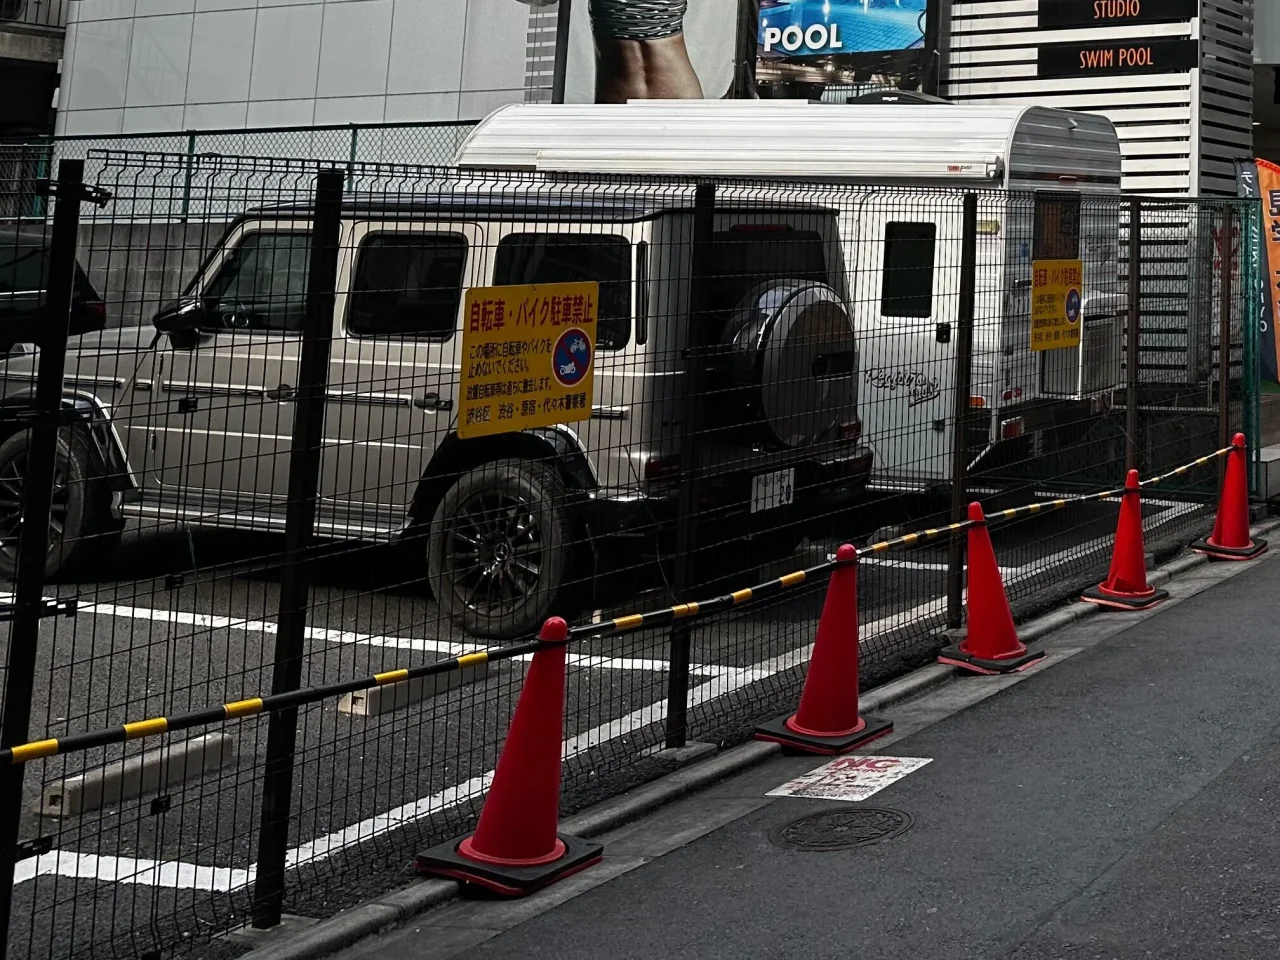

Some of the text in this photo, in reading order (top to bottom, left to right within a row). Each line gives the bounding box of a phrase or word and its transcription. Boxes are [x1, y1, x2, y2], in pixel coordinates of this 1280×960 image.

[763, 23, 843, 52] POOL
[1079, 47, 1154, 69] SWIM POOL
[469, 293, 593, 334] 自転車・バイク駐車禁止
[466, 404, 491, 424] 渋谷区
